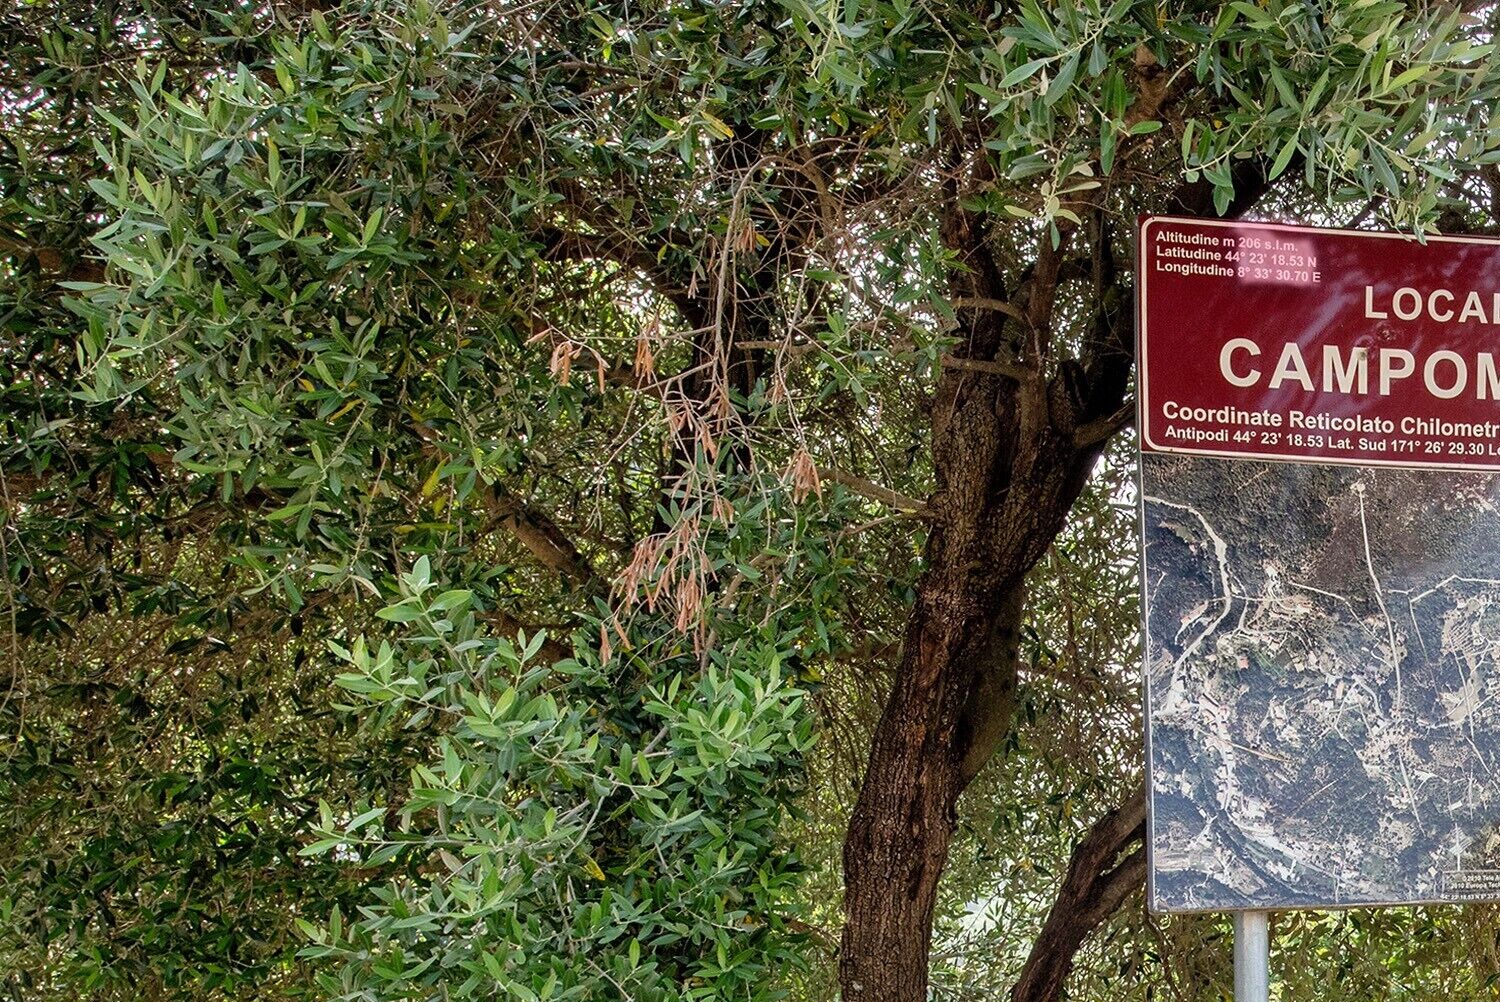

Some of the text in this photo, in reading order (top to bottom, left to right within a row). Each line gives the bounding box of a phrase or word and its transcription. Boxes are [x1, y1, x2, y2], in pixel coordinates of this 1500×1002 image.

[1156, 230, 1298, 252] Altitudine m 206 s.l.m.
[1156, 245, 1317, 267] Latitudine 44° 23' 18.53 N
[1156, 260, 1234, 276] Longitudine
[1237, 266, 1250, 278] 8°
[1276, 269, 1309, 281] 30.70
[1312, 271, 1321, 283] E
[1162, 400, 1283, 427] Coordinate
[1289, 410, 1395, 434] Reticolato
[1165, 425, 1229, 443] Antipodi
[1232, 430, 1257, 443] 44°
[1260, 431, 1282, 445] 23'
[1286, 433, 1324, 448] 18.53
[1328, 435, 1354, 450] Lat.
[1358, 437, 1387, 452] Sud
[1390, 439, 1421, 453] 171°
[1448, 442, 1484, 456] 29.30
